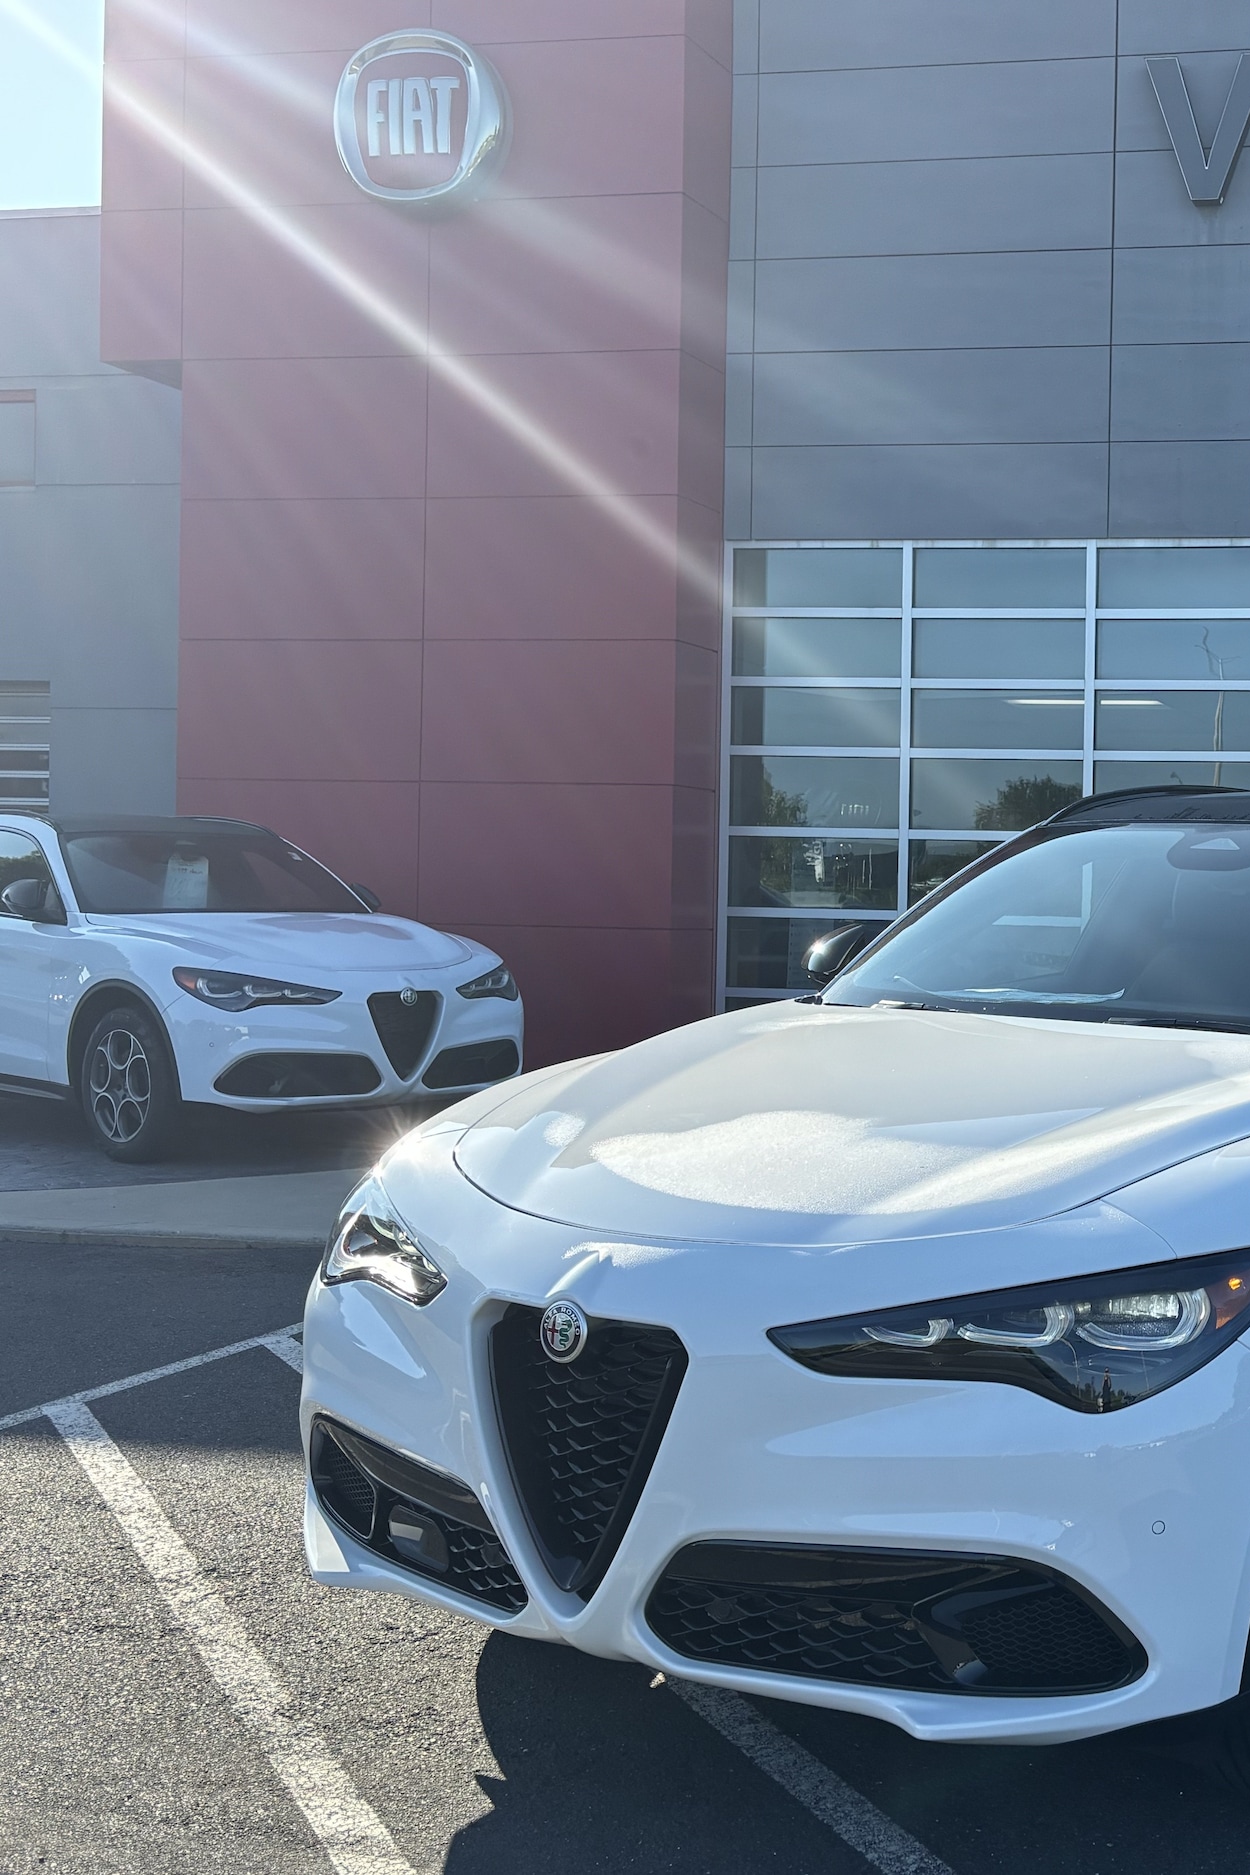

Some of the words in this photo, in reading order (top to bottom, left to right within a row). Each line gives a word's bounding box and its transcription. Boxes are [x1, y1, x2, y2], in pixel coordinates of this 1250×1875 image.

[367, 76, 460, 157] FIAT
[544, 1309, 558, 1330] ALFA
[561, 1307, 581, 1336] ROMEO
